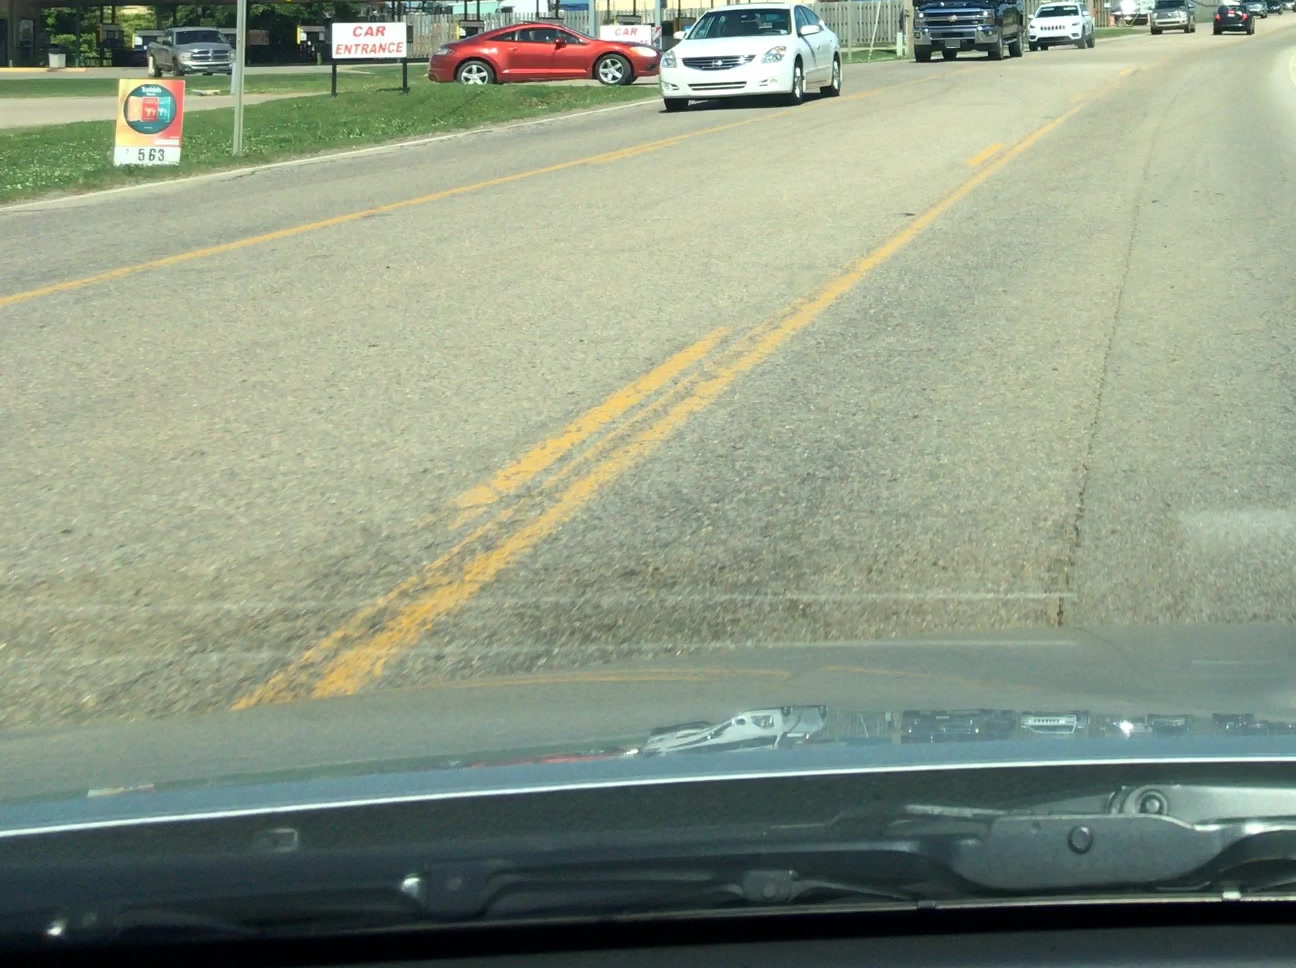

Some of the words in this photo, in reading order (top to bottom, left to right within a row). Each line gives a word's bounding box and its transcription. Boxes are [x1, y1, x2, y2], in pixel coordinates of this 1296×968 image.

[352, 26, 386, 37] CAR
[615, 27, 638, 36] CAR
[335, 42, 403, 55] ENTRANCE
